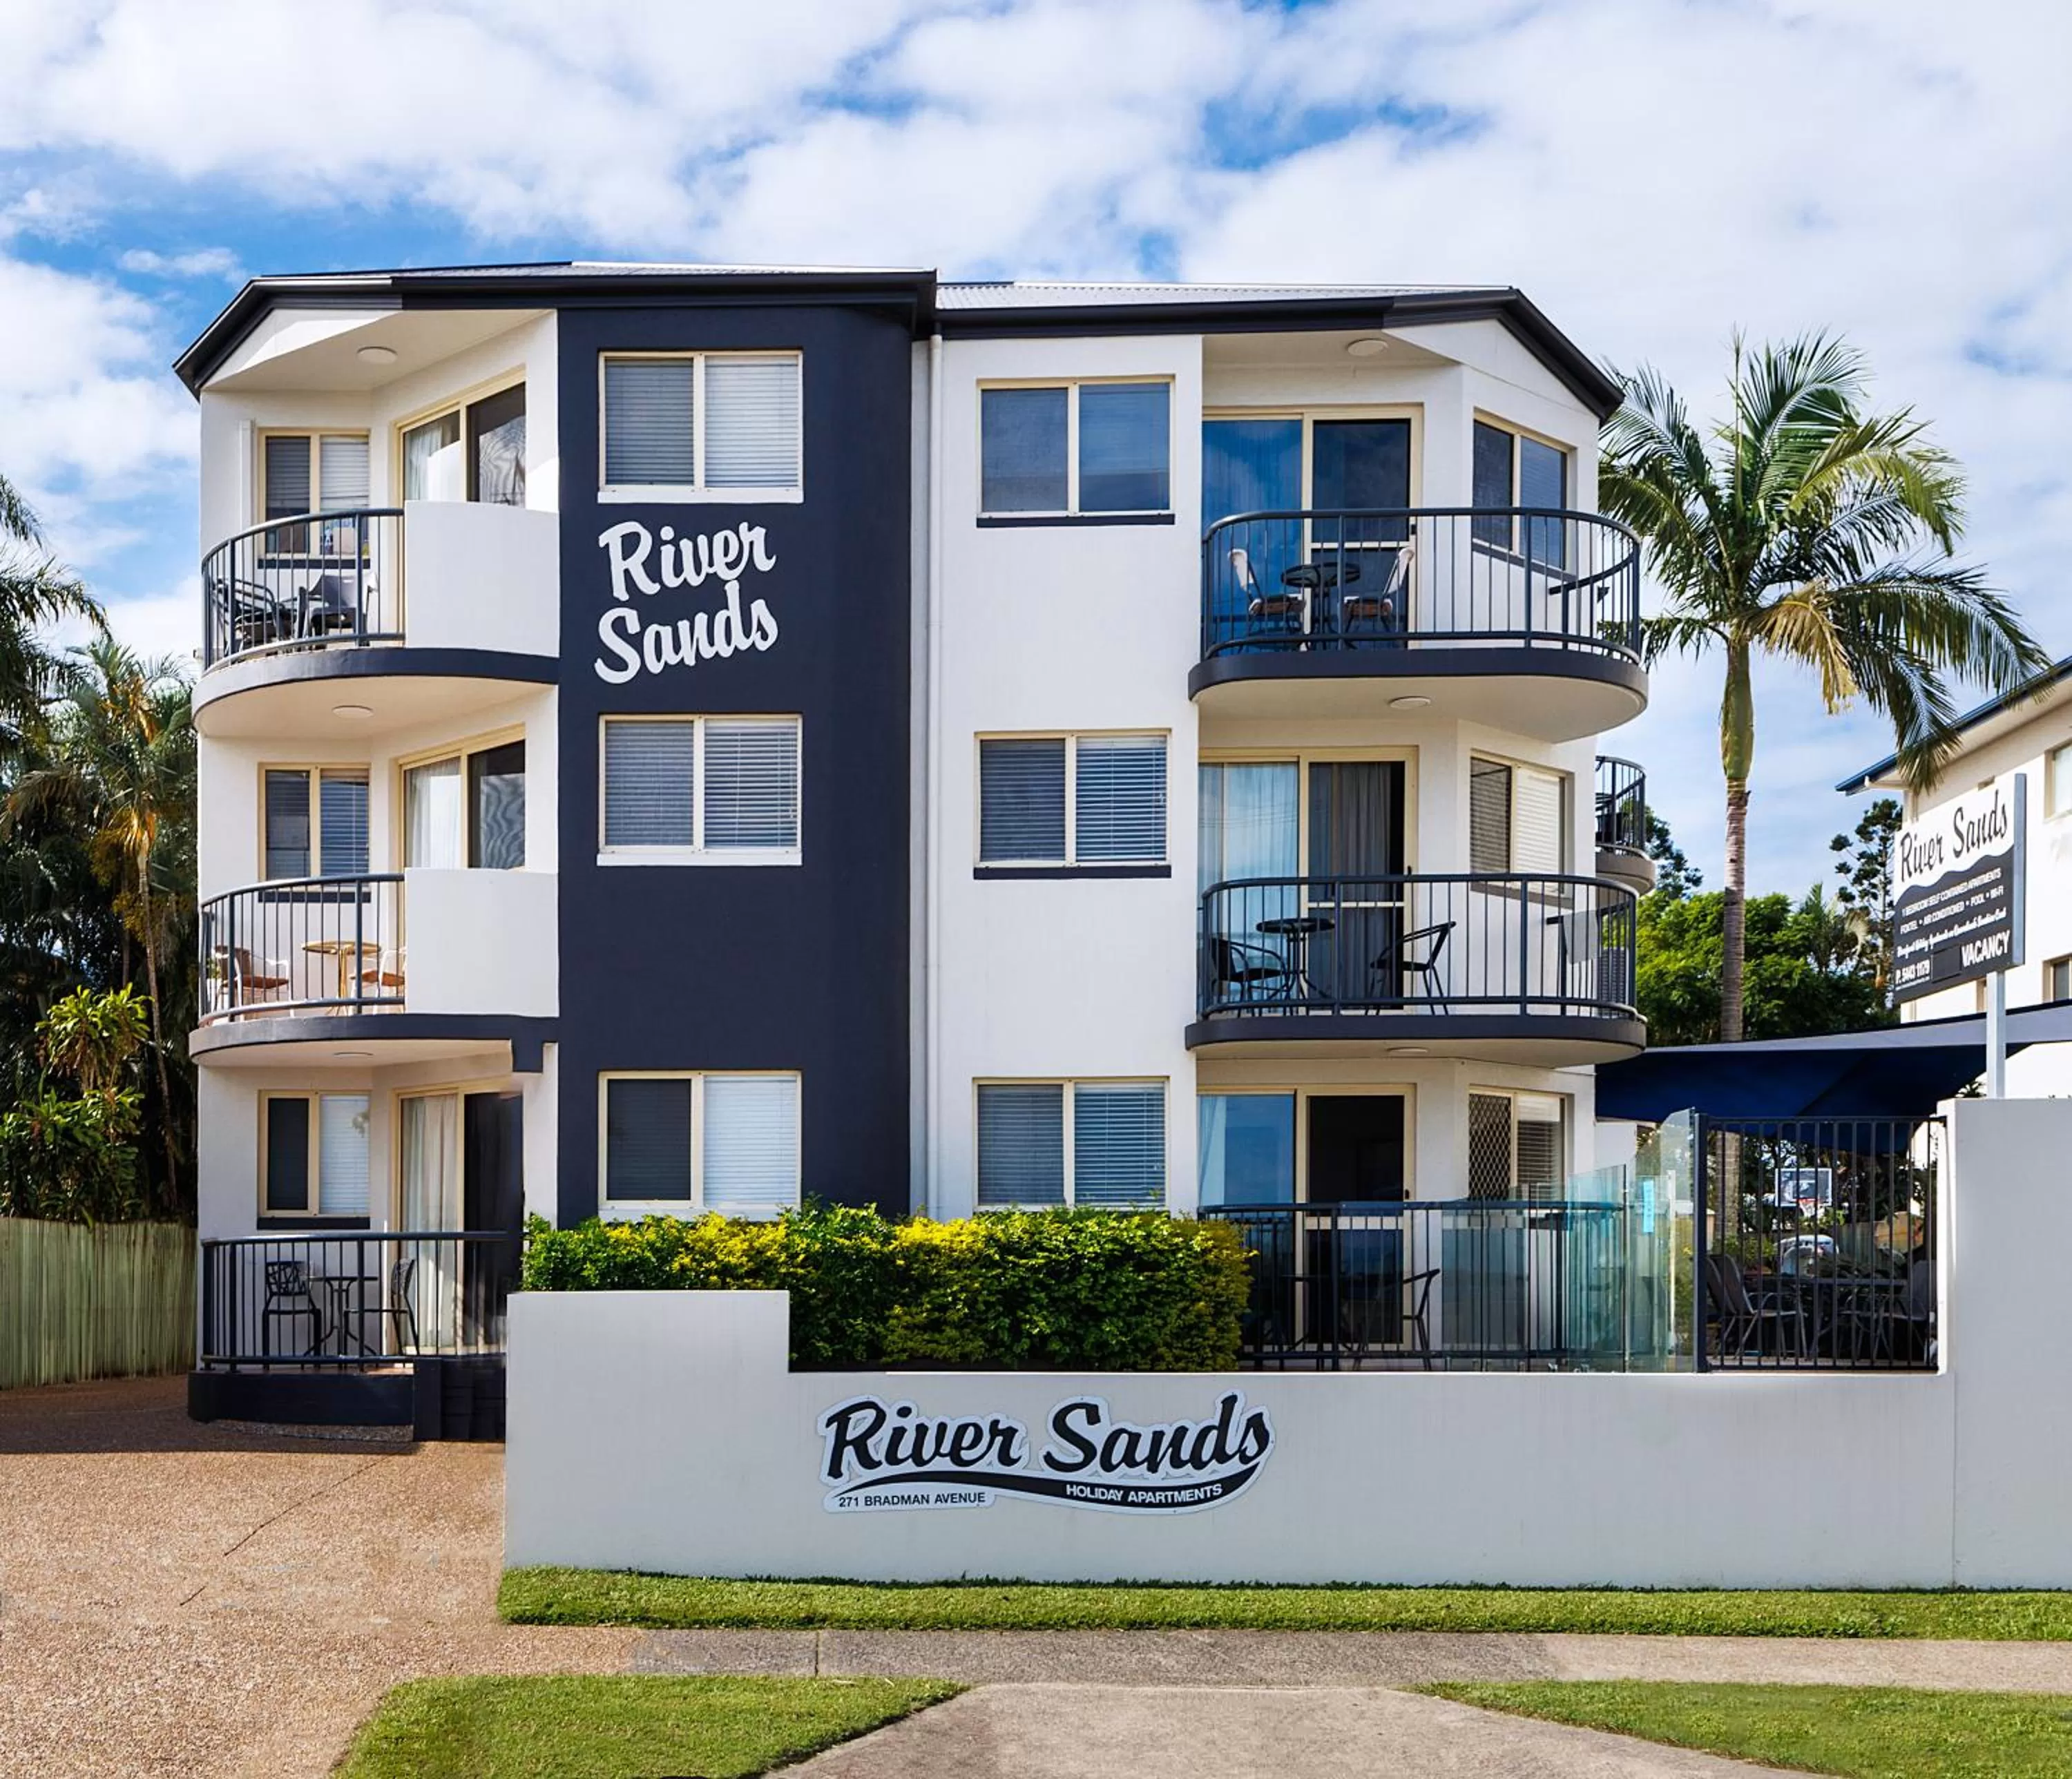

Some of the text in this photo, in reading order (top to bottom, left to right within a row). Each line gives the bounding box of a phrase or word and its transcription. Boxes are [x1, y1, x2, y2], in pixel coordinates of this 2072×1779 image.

[599, 521, 776, 601] River
[594, 579, 778, 684] Sands
[1900, 789, 2007, 883] River Sands
[1970, 894, 1986, 906] POOL
[1961, 930, 2011, 968] VACANCY
[825, 1394, 1270, 1479] River Sands
[838, 1492, 986, 1508] 271 BRADMAN AVENUE
[1066, 1484, 1223, 1504] HOLIDAY APARTMENTS
